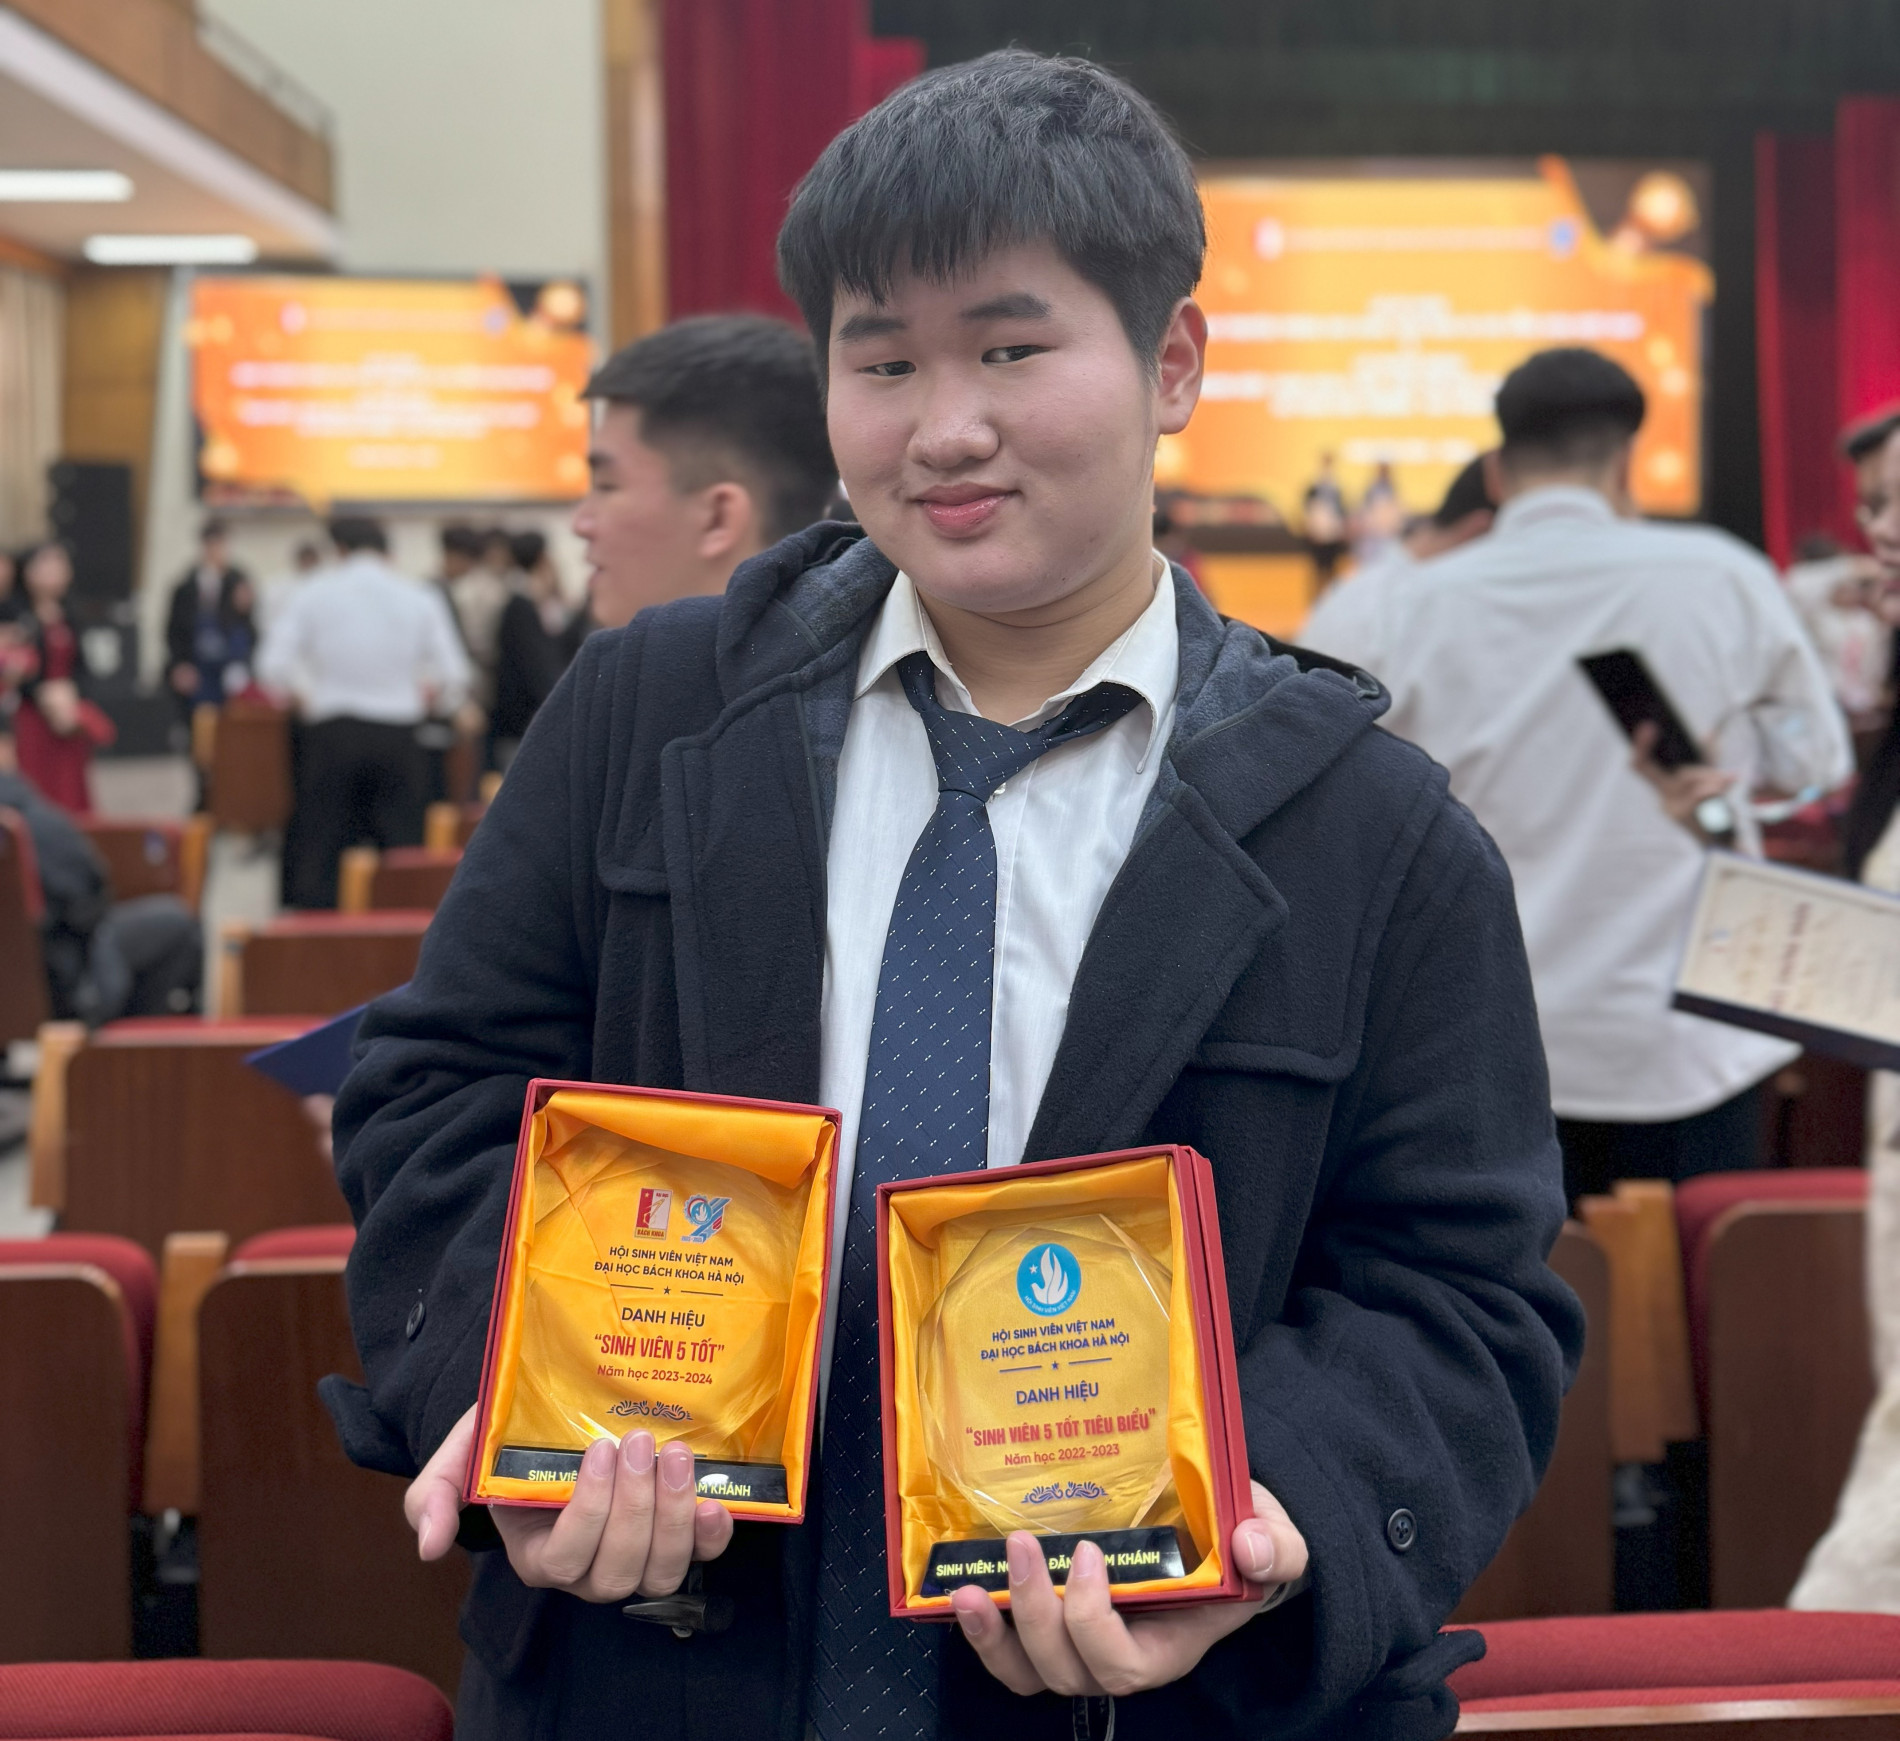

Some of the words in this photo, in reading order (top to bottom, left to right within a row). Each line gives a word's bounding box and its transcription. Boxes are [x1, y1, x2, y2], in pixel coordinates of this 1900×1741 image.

[610, 1246, 629, 1259] HỘI
[632, 1248, 656, 1259] SINH
[659, 1250, 682, 1262] VIÊN
[685, 1252, 707, 1266] VIỆT
[710, 1256, 733, 1267] NAM
[594, 1261, 614, 1274] ĐẠI
[616, 1263, 640, 1276] HỌC
[643, 1264, 672, 1277] BÁCH
[675, 1269, 705, 1280] KHOA
[708, 1270, 722, 1281] HÀ
[725, 1272, 744, 1286] NỘI
[621, 1307, 666, 1324] DANH
[670, 1310, 706, 1330] HIỆU
[992, 1329, 1010, 1343] HỘI
[1013, 1328, 1037, 1339] SINH
[1039, 1323, 1063, 1336] VIÊN
[1065, 1320, 1088, 1334] VIỆT
[1090, 1318, 1115, 1330] NAM
[594, 1334, 637, 1357] “SINH
[640, 1336, 674, 1360] VIÊN
[676, 1342, 687, 1361] 5
[690, 1338, 725, 1363] TỐT”
[981, 1348, 999, 1361] ĐẠI
[1002, 1345, 1025, 1359] HỌC
[1027, 1341, 1057, 1354] BÁCH
[1060, 1338, 1090, 1351] KHOA
[1092, 1334, 1107, 1346] HÀ
[1110, 1331, 1129, 1347] NỘI
[597, 1364, 625, 1377] Năm
[627, 1367, 649, 1381] học
[651, 1370, 713, 1385] 2023-2024
[1016, 1386, 1060, 1405] DANH
[1064, 1380, 1099, 1402] HIỆU
[966, 1427, 1005, 1446] “SINH
[1009, 1422, 1040, 1442] VIÊN
[1044, 1423, 1052, 1439] 5
[1055, 1415, 1080, 1438] TỐT
[1083, 1415, 1113, 1435] TIÊU
[1117, 1408, 1156, 1432] BIỂU”
[1004, 1451, 1031, 1466] Năm
[1034, 1450, 1055, 1465] học
[1058, 1443, 1120, 1461] 2022-2023
[528, 1470, 556, 1482] SINH
[559, 1470, 577, 1482] VIÊ
[710, 1481, 751, 1496] KHÁNH
[936, 1564, 963, 1577] SINH
[966, 1560, 995, 1575] VIÊN:
[1049, 1554, 1074, 1570] ĐĂN
[1117, 1551, 1160, 1566] KHÁNH
